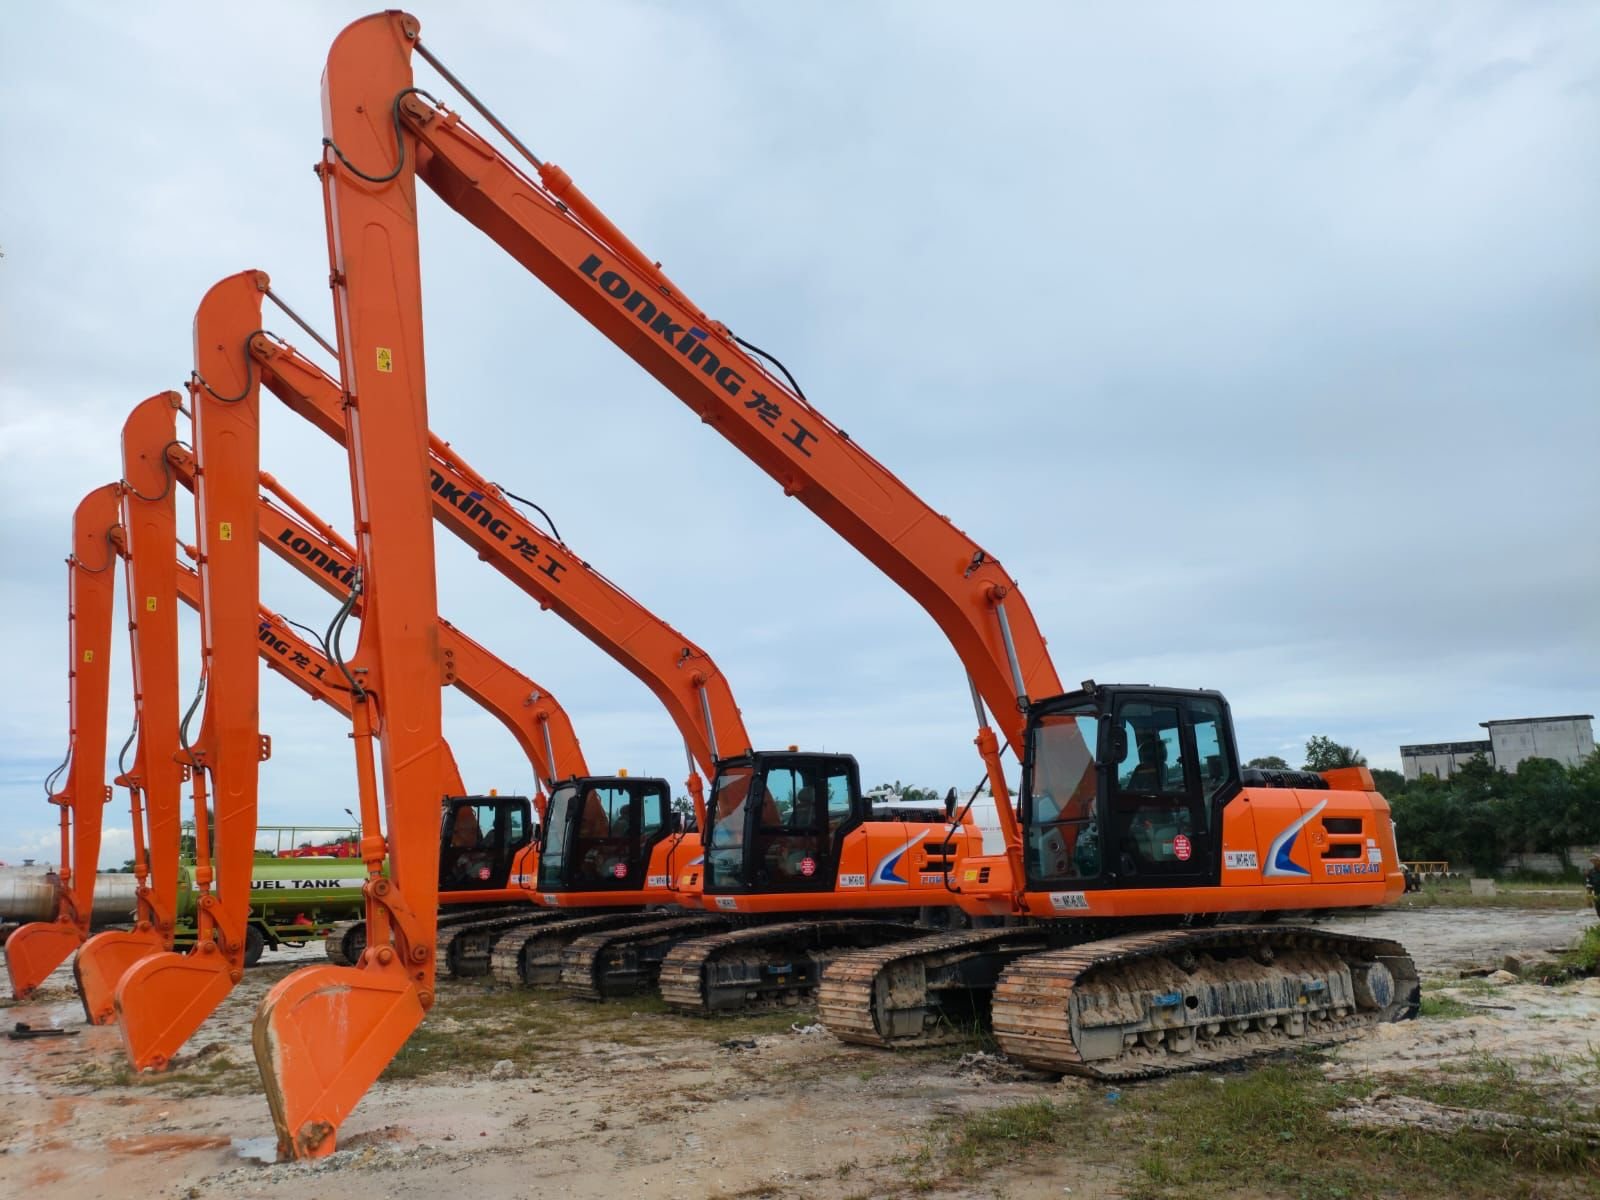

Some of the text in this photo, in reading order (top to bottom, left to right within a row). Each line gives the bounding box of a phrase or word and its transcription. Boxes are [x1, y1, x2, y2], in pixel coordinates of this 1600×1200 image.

[578, 254, 819, 457] LONKING 龙工
[430, 468, 512, 541] NKING
[278, 528, 364, 596] LONKI
[250, 879, 341, 890] UEL TANK
